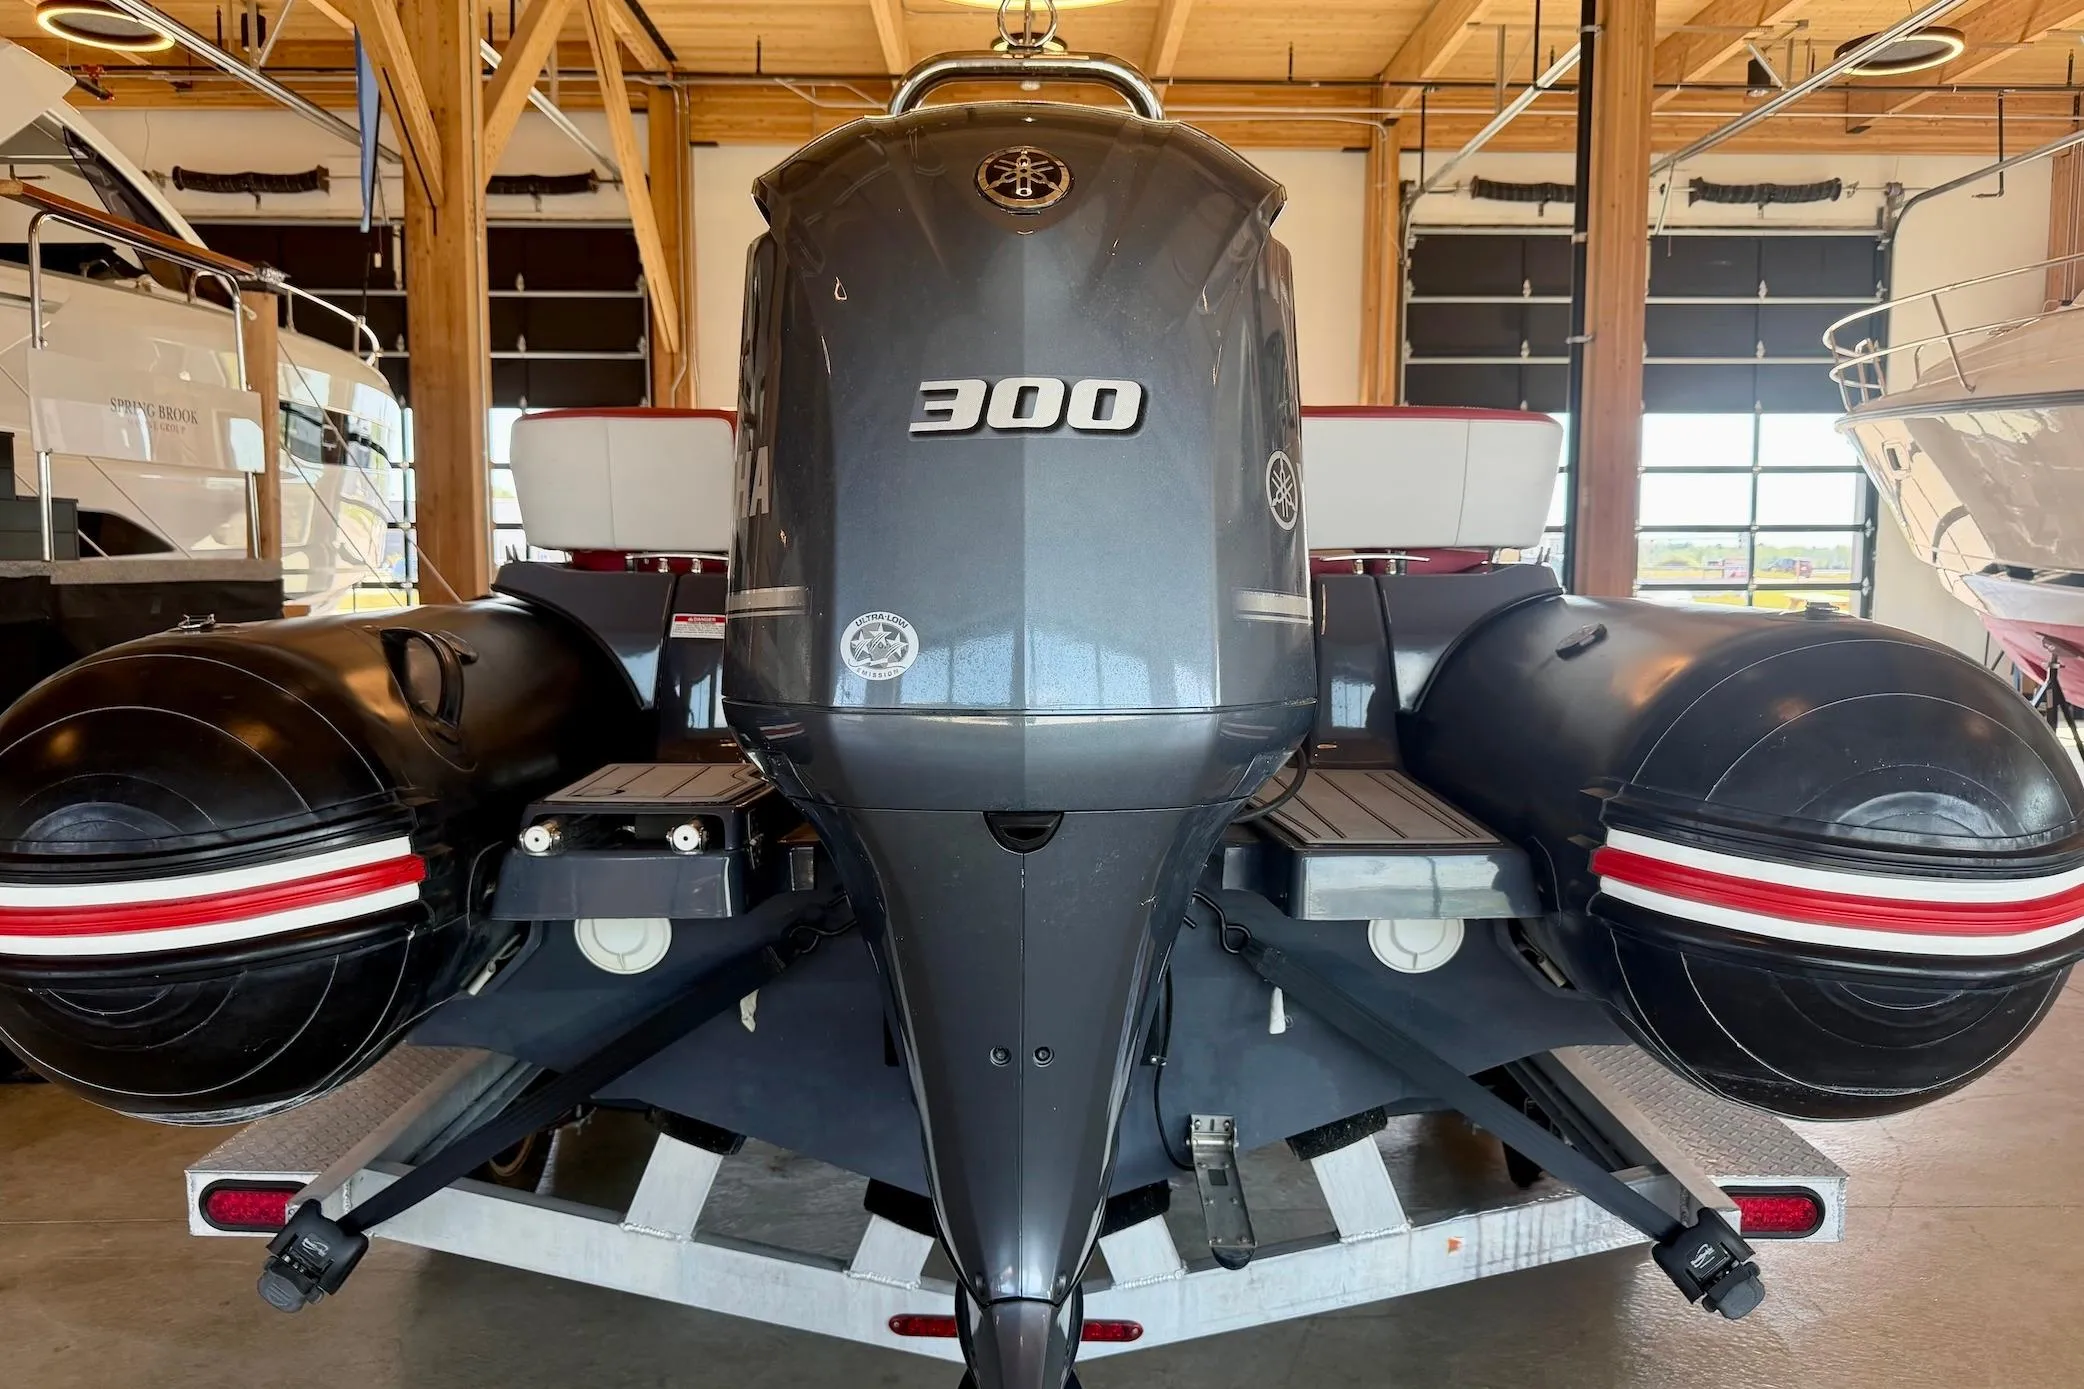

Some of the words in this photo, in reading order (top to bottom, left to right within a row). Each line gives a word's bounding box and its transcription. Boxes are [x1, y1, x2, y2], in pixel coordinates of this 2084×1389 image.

[110, 397, 155, 417] SPRING
[158, 404, 198, 424] BROOK
[909, 377, 1142, 433] 300
[856, 667, 899, 678] EMISSION
